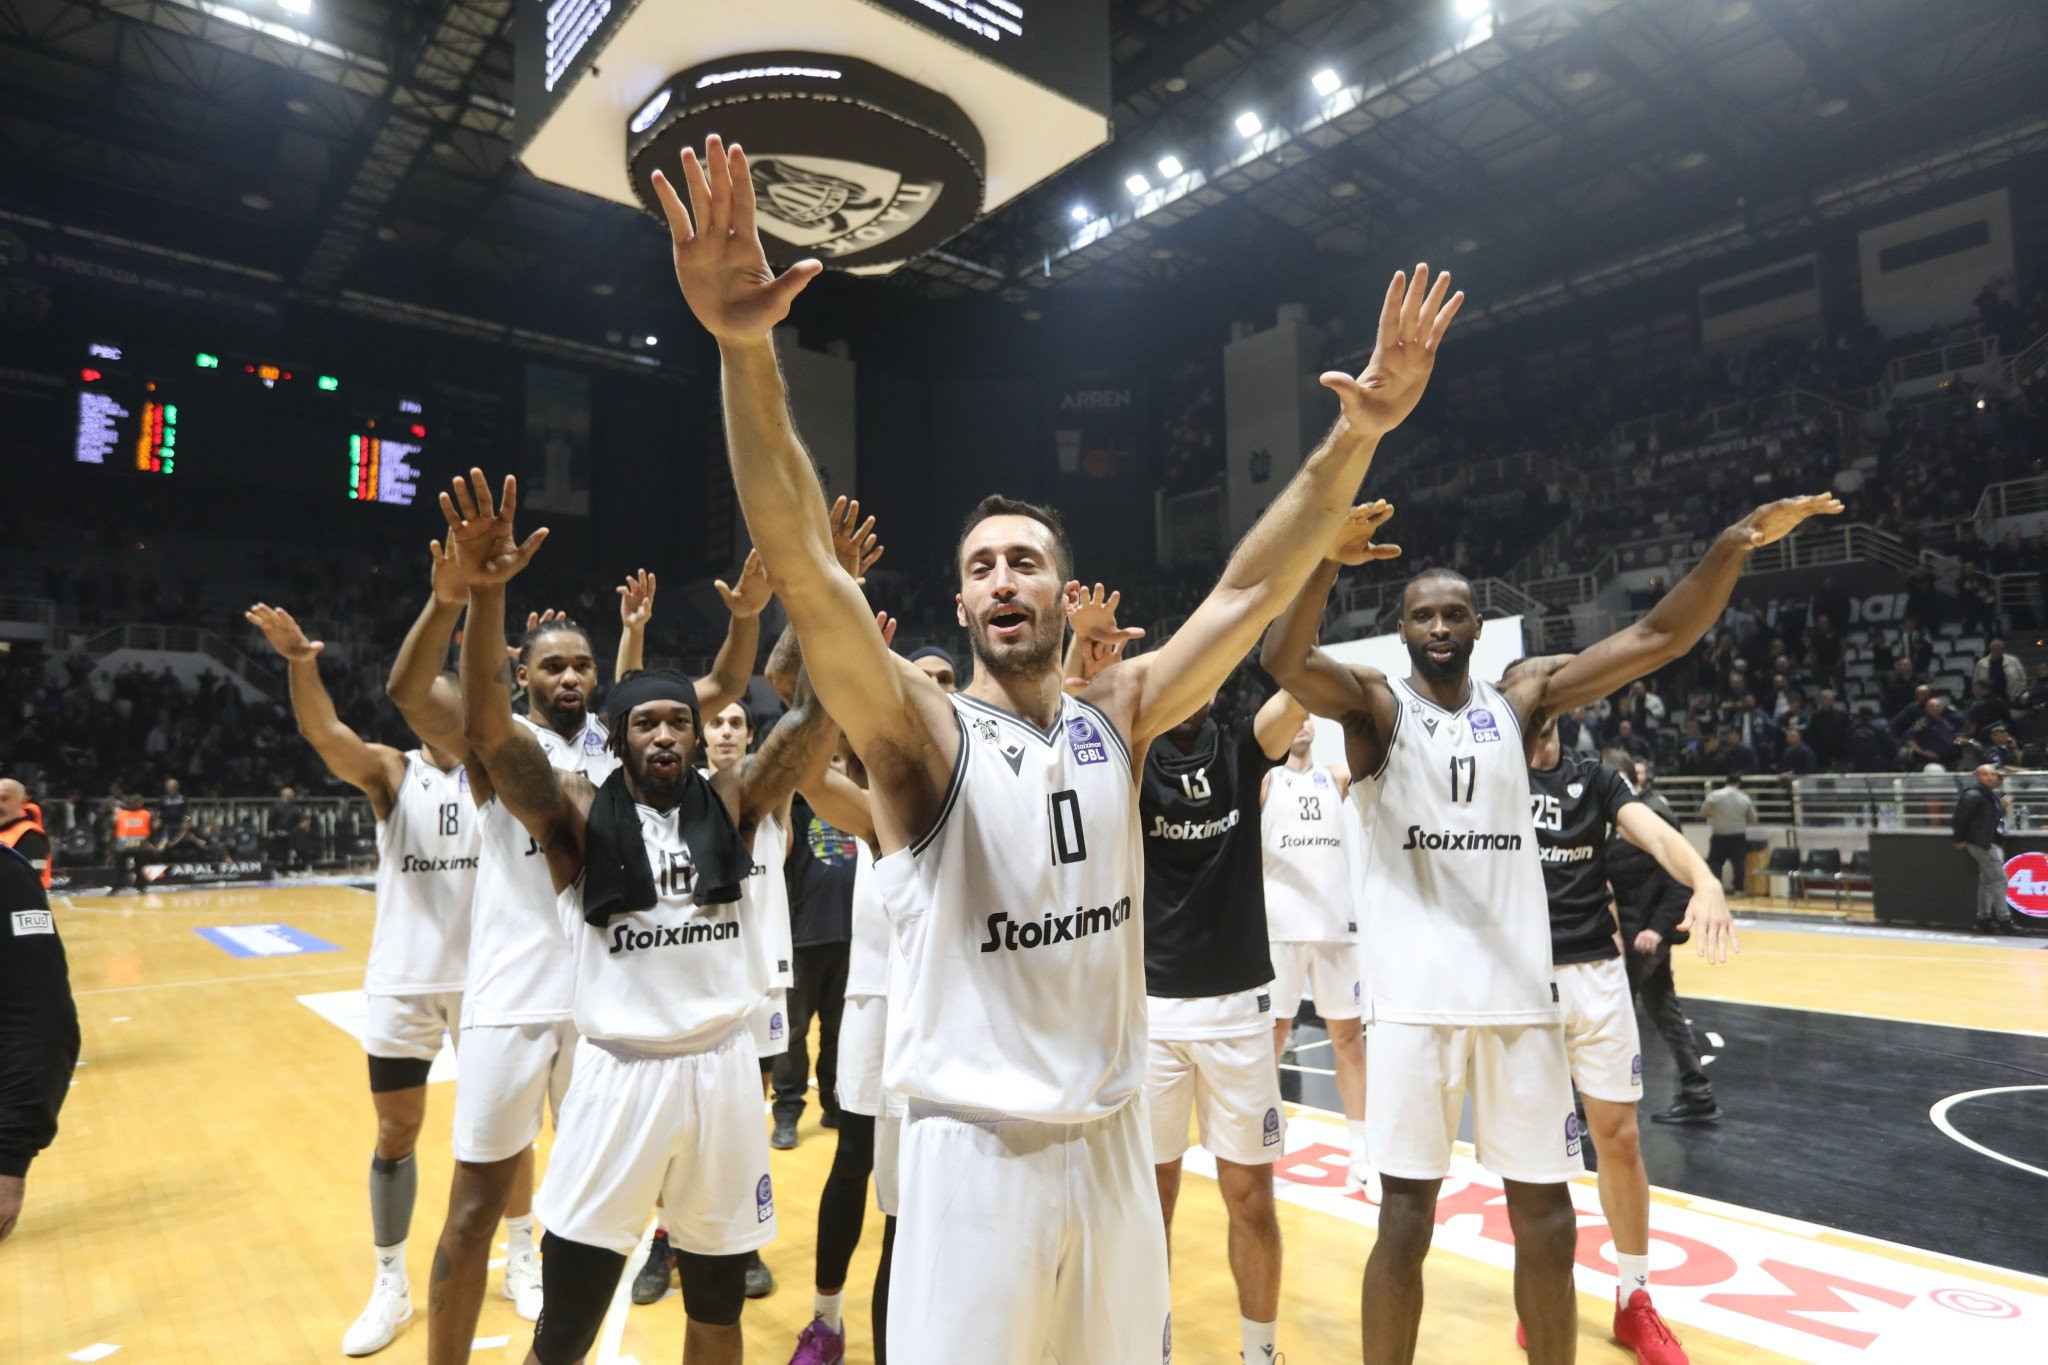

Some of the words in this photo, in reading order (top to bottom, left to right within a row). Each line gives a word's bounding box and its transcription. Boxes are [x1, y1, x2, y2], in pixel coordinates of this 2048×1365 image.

[1077, 749, 1105, 763] GBL
[1449, 755, 1476, 803] 17
[439, 802, 459, 836] 18
[1150, 808, 1241, 841] Stoiximan
[1298, 796, 1322, 821] 33
[1529, 794, 1562, 831] 25
[1402, 825, 1522, 851] Stoiximan
[171, 863, 216, 876] ARAL
[218, 861, 262, 875] FARM
[658, 849, 695, 896] 16
[15, 911, 50, 928] TRUST
[980, 895, 1131, 953] Stoiximan
[609, 920, 740, 954] Stoiximan
[1273, 1141, 1917, 1351] ΒΚΟΣ
